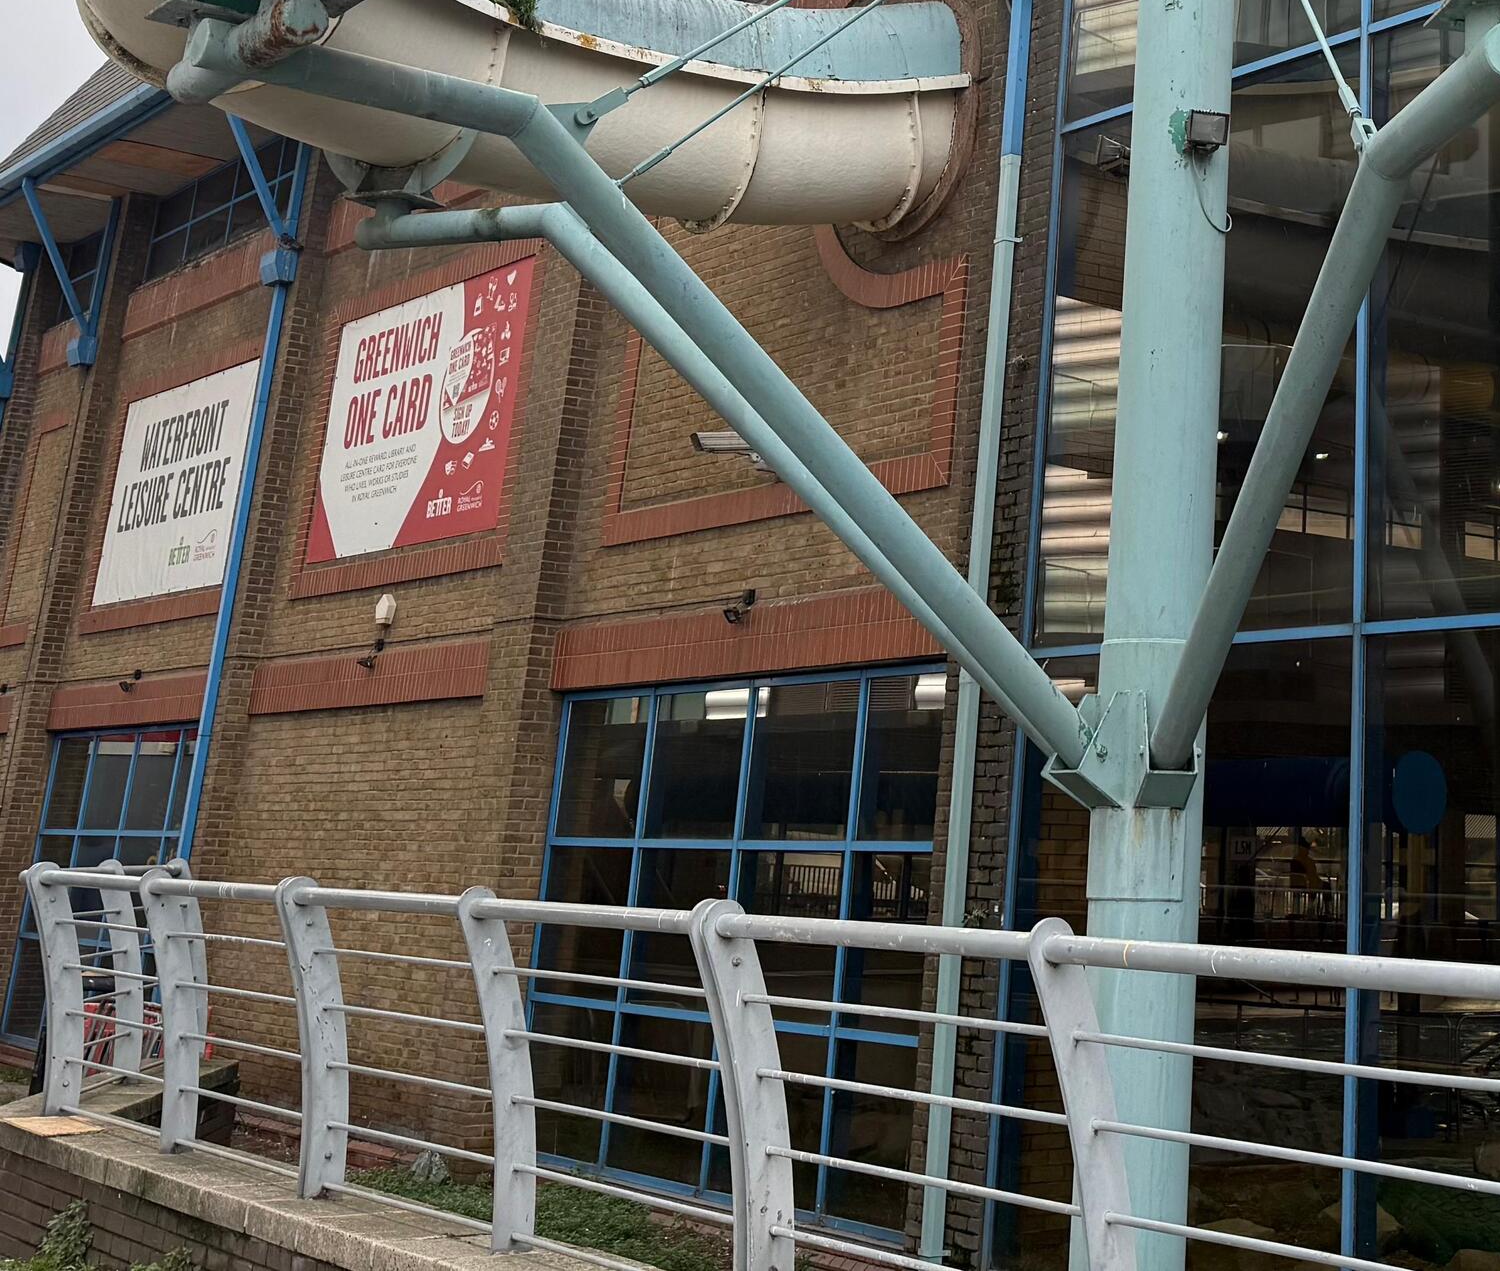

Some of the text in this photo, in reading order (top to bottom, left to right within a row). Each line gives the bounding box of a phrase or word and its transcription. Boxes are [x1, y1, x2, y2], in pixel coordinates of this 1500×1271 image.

[353, 311, 443, 384] GREENWICH
[139, 399, 230, 472] WATERFRONT
[344, 374, 433, 449] ONE CARD
[405, 443, 416, 453] AND
[116, 456, 231, 533] LEISURE CENTRE
[426, 497, 452, 518] BETTER
[168, 545, 191, 566] BETTER
